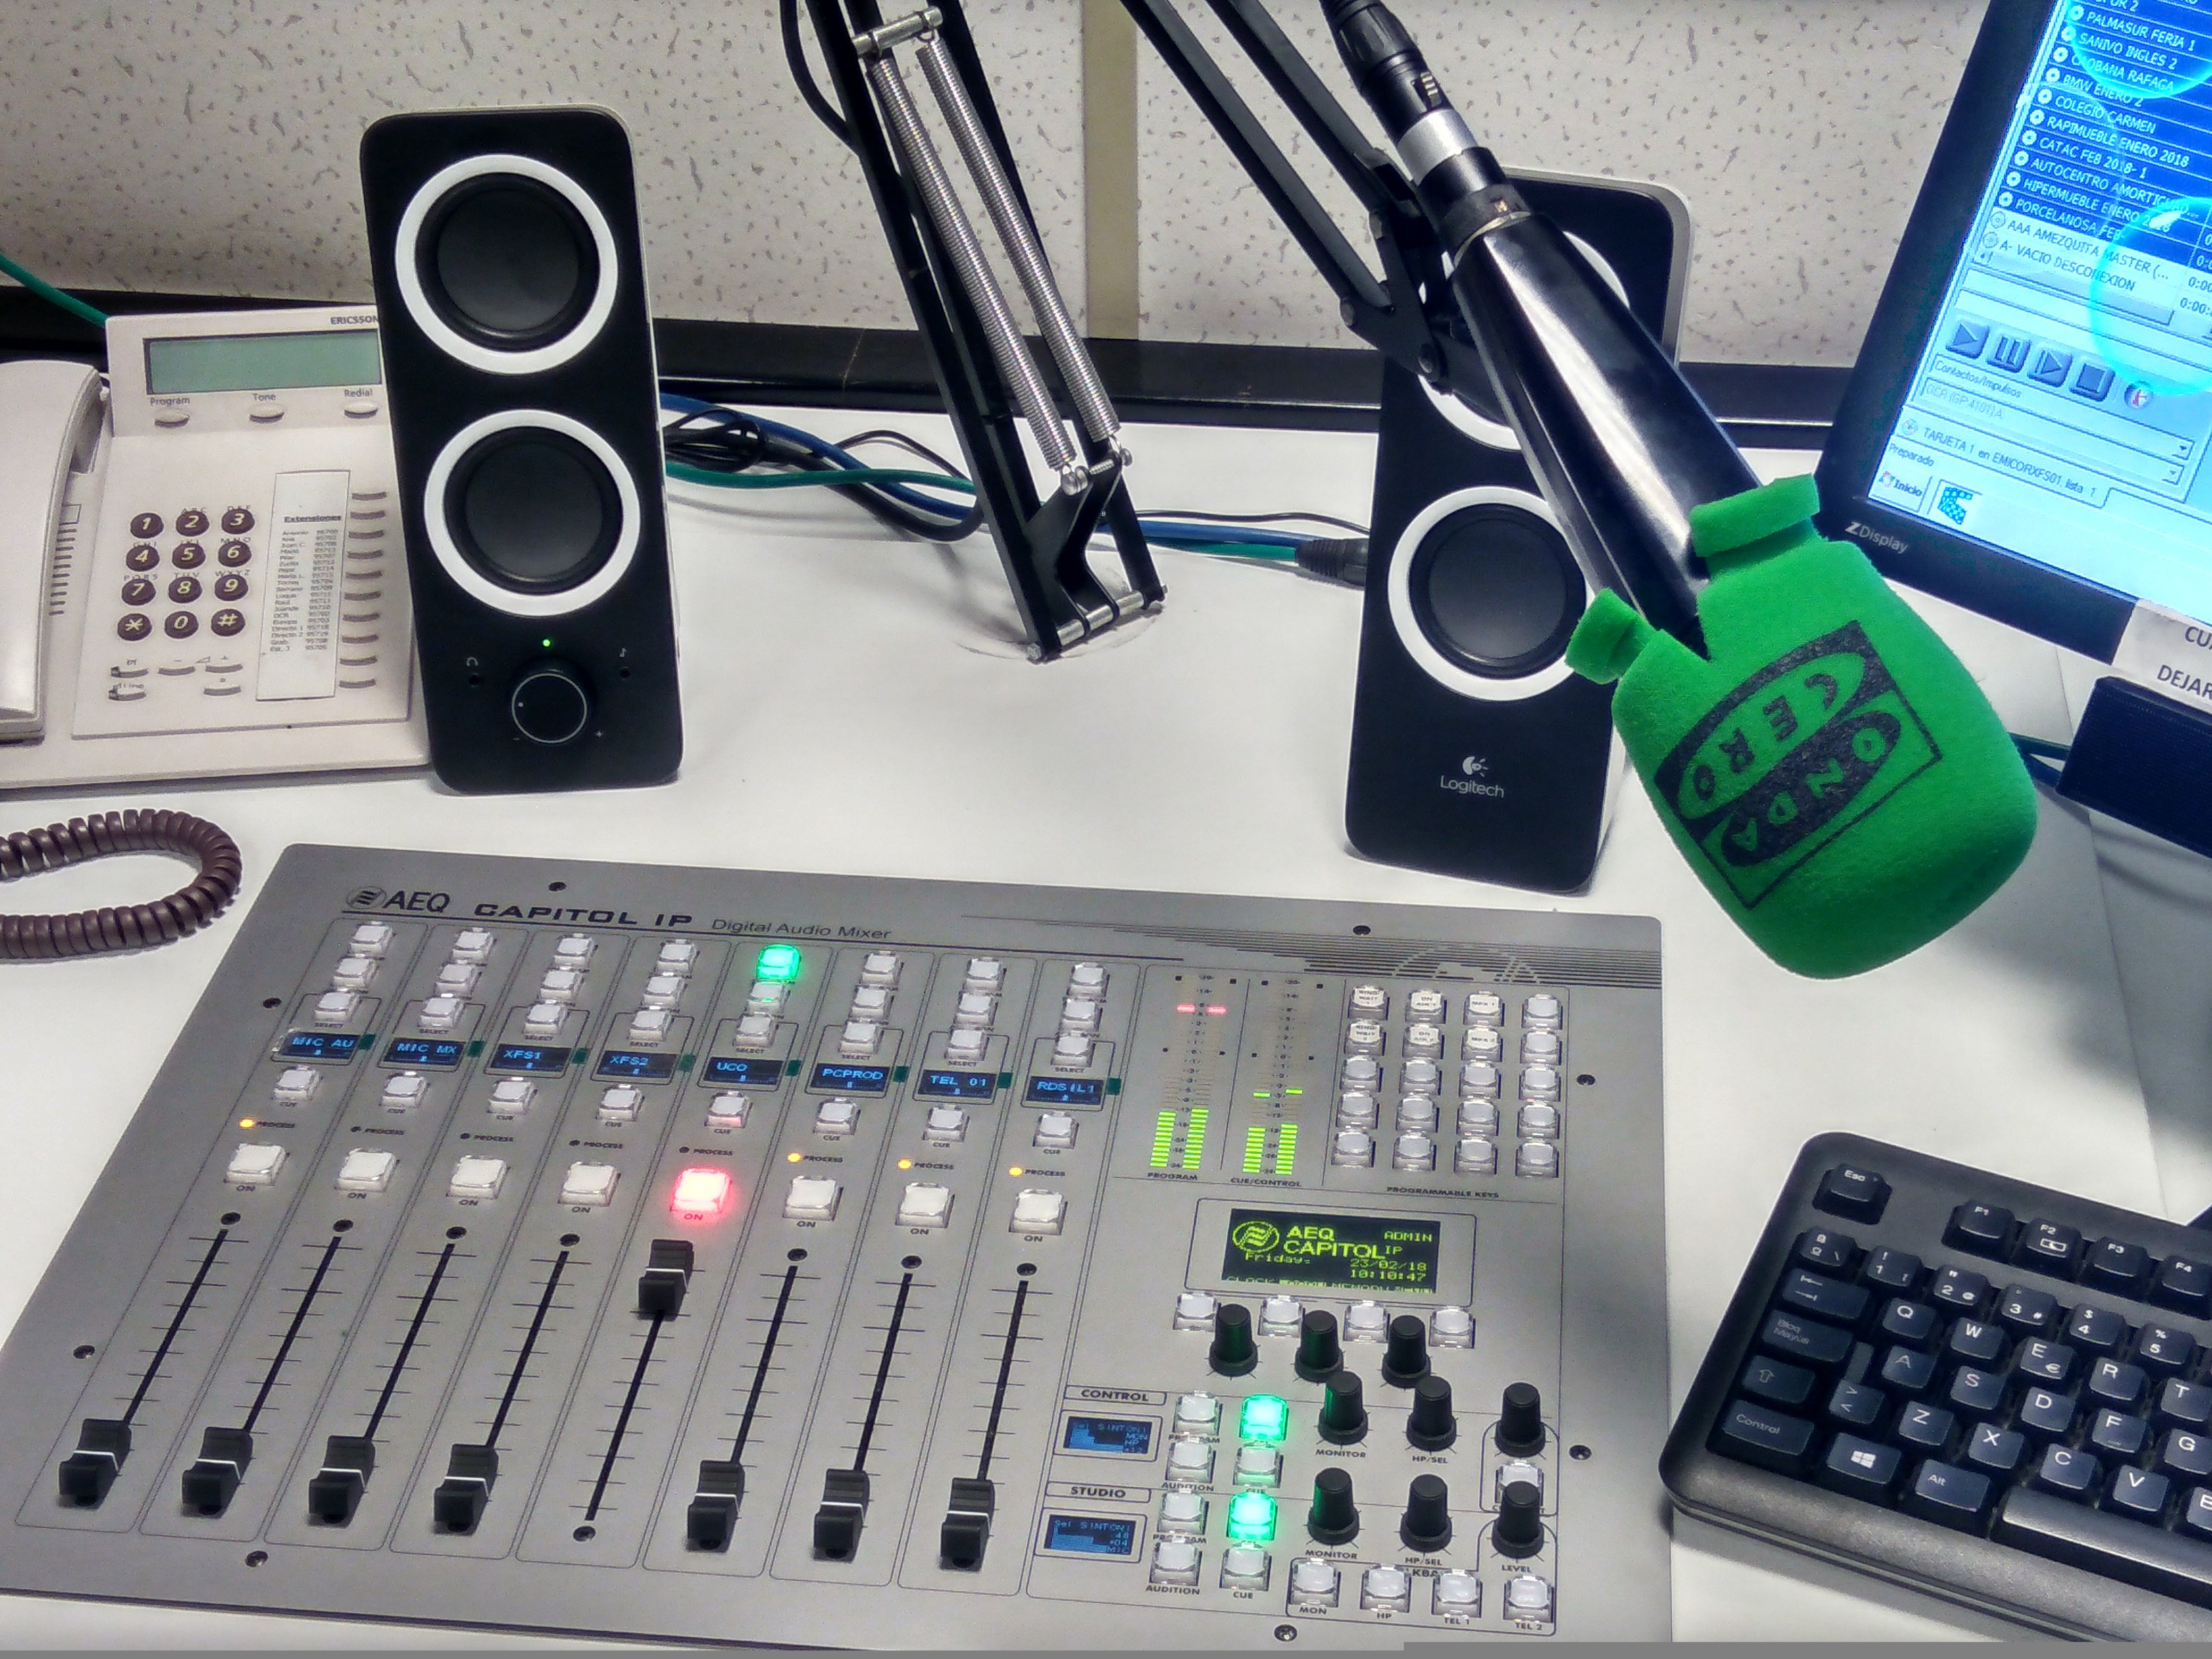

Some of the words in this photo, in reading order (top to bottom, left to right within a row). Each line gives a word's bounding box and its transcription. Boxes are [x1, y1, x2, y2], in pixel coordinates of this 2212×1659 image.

[2086, 11, 2149, 38] PALMASUR
[2150, 29, 2184, 48] FERIA
[2078, 32, 2123, 54] SANIVO
[2125, 45, 2168, 68] INGLES
[2168, 57, 2178, 70] 2
[2063, 74, 2093, 91] BMW
[2093, 84, 2133, 104] ENERO
[2134, 97, 2144, 107] 2
[2127, 70, 2174, 91] RAFAGA
[2055, 96, 2105, 119] COLEGIO
[2107, 110, 2157, 133] CARMEN
[2040, 137, 2080, 158] CATAC
[2047, 116, 2117, 147] RAPIMUEBLE
[2121, 138, 2158, 158] ENERO
[2159, 149, 2190, 168] 2018
[2030, 157, 2109, 190] AUTOCENTRO
[2023, 178, 2099, 211] HIPERMUEBLE
[2101, 202, 2139, 224] ENERO
[2015, 198, 2098, 233] PORCELANOSA
[2007, 220, 2031, 236] AAA
[2034, 228, 2099, 257] AMEZQUITA
[2104, 248, 2150, 274] MASTER
[1999, 239, 2012, 251] A-
[2017, 244, 2052, 265] VACIO
[2054, 256, 2136, 291] DESCONEXION
[330, 315, 379, 325] ERICSSON
[1935, 360, 2022, 398] Contactos/Impulsos
[150, 397, 190, 407] Program
[253, 393, 276, 401] Tone
[344, 389, 373, 398] Redial
[1888, 442, 1934, 466] Preparado
[1923, 427, 1967, 451] TARJETA
[1978, 450, 1990, 460] en
[2065, 478, 2084, 493] lista
[2090, 487, 2097, 497] 1
[1893, 479, 1922, 497] Inicio
[142, 517, 152, 531] 1
[185, 515, 199, 529] 2
[230, 513, 245, 527] 3
[136, 549, 149, 563] 4
[181, 547, 196, 561] 5
[227, 544, 241, 559] 6
[132, 583, 145, 597] 7
[177, 581, 191, 594] 8
[224, 578, 239, 592] 9
[173, 616, 189, 630] 0
[2157, 664, 2212, 700] DEJAR
[1693, 673, 1839, 801] CERO
[1440, 775, 1505, 798] Logitech
[1731, 726, 1887, 852] ONDA
[382, 890, 451, 913] AEQ
[474, 903, 638, 925] CAPITOL
[655, 914, 692, 927] IP
[712, 919, 773, 934] Digital
[775, 923, 831, 936] Audio
[837, 926, 892, 939] Mixer
[292, 1036, 324, 1047] MIC
[331, 1037, 355, 1048] AU
[397, 1043, 430, 1053] MIC
[437, 1045, 457, 1054] MX
[503, 1050, 542, 1060] XFS1
[609, 1054, 650, 1066] XFS2
[716, 1061, 748, 1073] UCO
[821, 1067, 884, 1080] PCPROD
[931, 1074, 958, 1086] TEL
[968, 1077, 987, 1087] 01
[1147, 1171, 1198, 1181] PROGRAM
[1230, 1176, 1302, 1188] CUE/CONTROL
[1387, 1186, 1471, 1197] PROGRAMMABLE
[1844, 1170, 1865, 1182] Esc
[2040, 1224, 2056, 1235] F2
[2108, 1243, 2125, 1254] F3
[2176, 1262, 2192, 1273] F4
[1024, 1235, 1043, 1243] ON
[1286, 1226, 1335, 1242] AEQ
[1384, 1230, 1433, 1243] ADMIN
[1283, 1239, 1385, 1260] CAPITOL
[1385, 1245, 1403, 1255] IP
[1350, 1258, 1428, 1272] 23/02/18
[1777, 1319, 1802, 1334] Bloq
[1942, 1285, 1953, 1295] 2
[2009, 1303, 2022, 1314] 3
[2077, 1324, 2090, 1335] 4
[2149, 1343, 2161, 1354] 5
[1896, 1305, 1914, 1319] Q
[1965, 1323, 1982, 1338] W
[2031, 1343, 2047, 1358] E
[2102, 1363, 2119, 1378] R
[2175, 1384, 2190, 1398] T
[1080, 1388, 1150, 1403] CONTROL
[1895, 1354, 1912, 1369] A
[1964, 1373, 1980, 1388] S
[2034, 1394, 2052, 1410] D
[2105, 1414, 2122, 1428] F
[2179, 1436, 2196, 1452] G
[1316, 1448, 1367, 1459] MONITOR
[1412, 1455, 1448, 1464] HP/SEL
[1736, 1413, 1781, 1435] Control
[1928, 1473, 1946, 1487] Alt
[1912, 1409, 1932, 1425] Z
[1983, 1430, 1999, 1446] X
[2054, 1451, 2073, 1465] C
[2128, 1472, 2146, 1488] V
[1070, 1486, 1127, 1498] STUDIO
[1161, 1482, 1214, 1493] AUDITION
[1305, 1549, 1358, 1560] MONITOR
[1405, 1557, 1443, 1566] HP/SEL
[1502, 1564, 1532, 1573] LEVEL
[1145, 1585, 1200, 1596] AUDITION
[1300, 1606, 1327, 1615] MON
